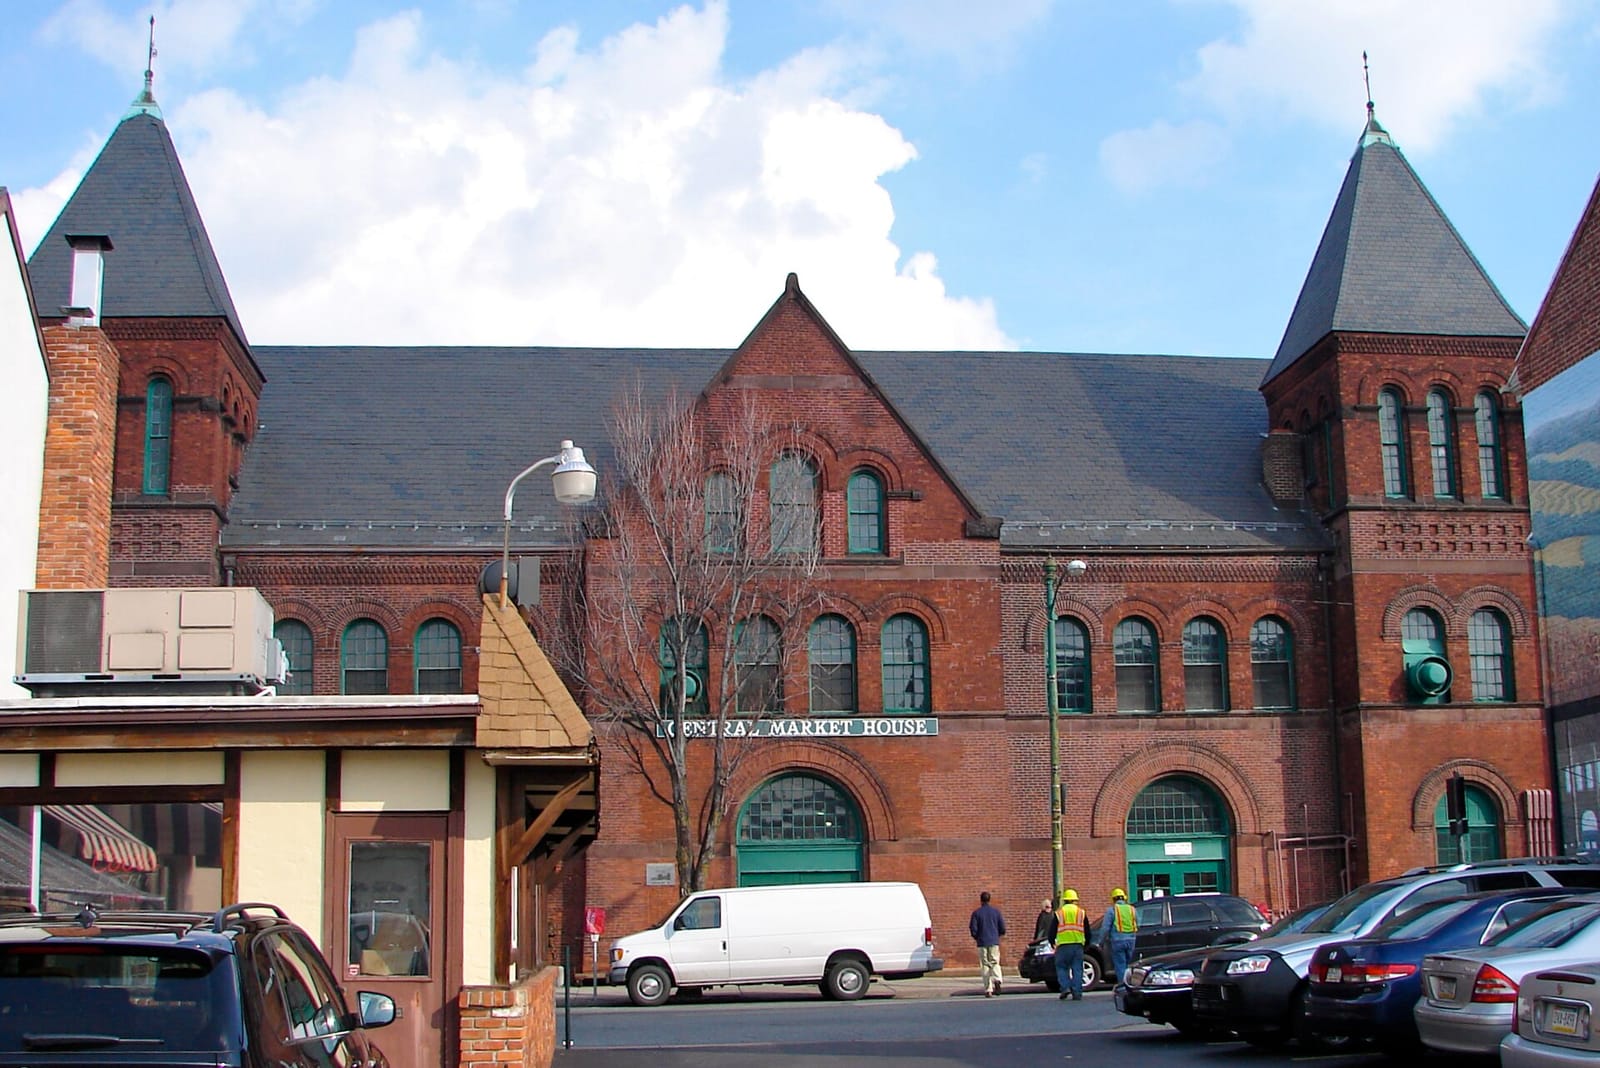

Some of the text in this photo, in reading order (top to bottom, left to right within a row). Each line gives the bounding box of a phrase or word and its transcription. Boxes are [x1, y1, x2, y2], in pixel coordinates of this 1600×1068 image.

[667, 719, 928, 737] CENTRAL MARKET HOUSE
